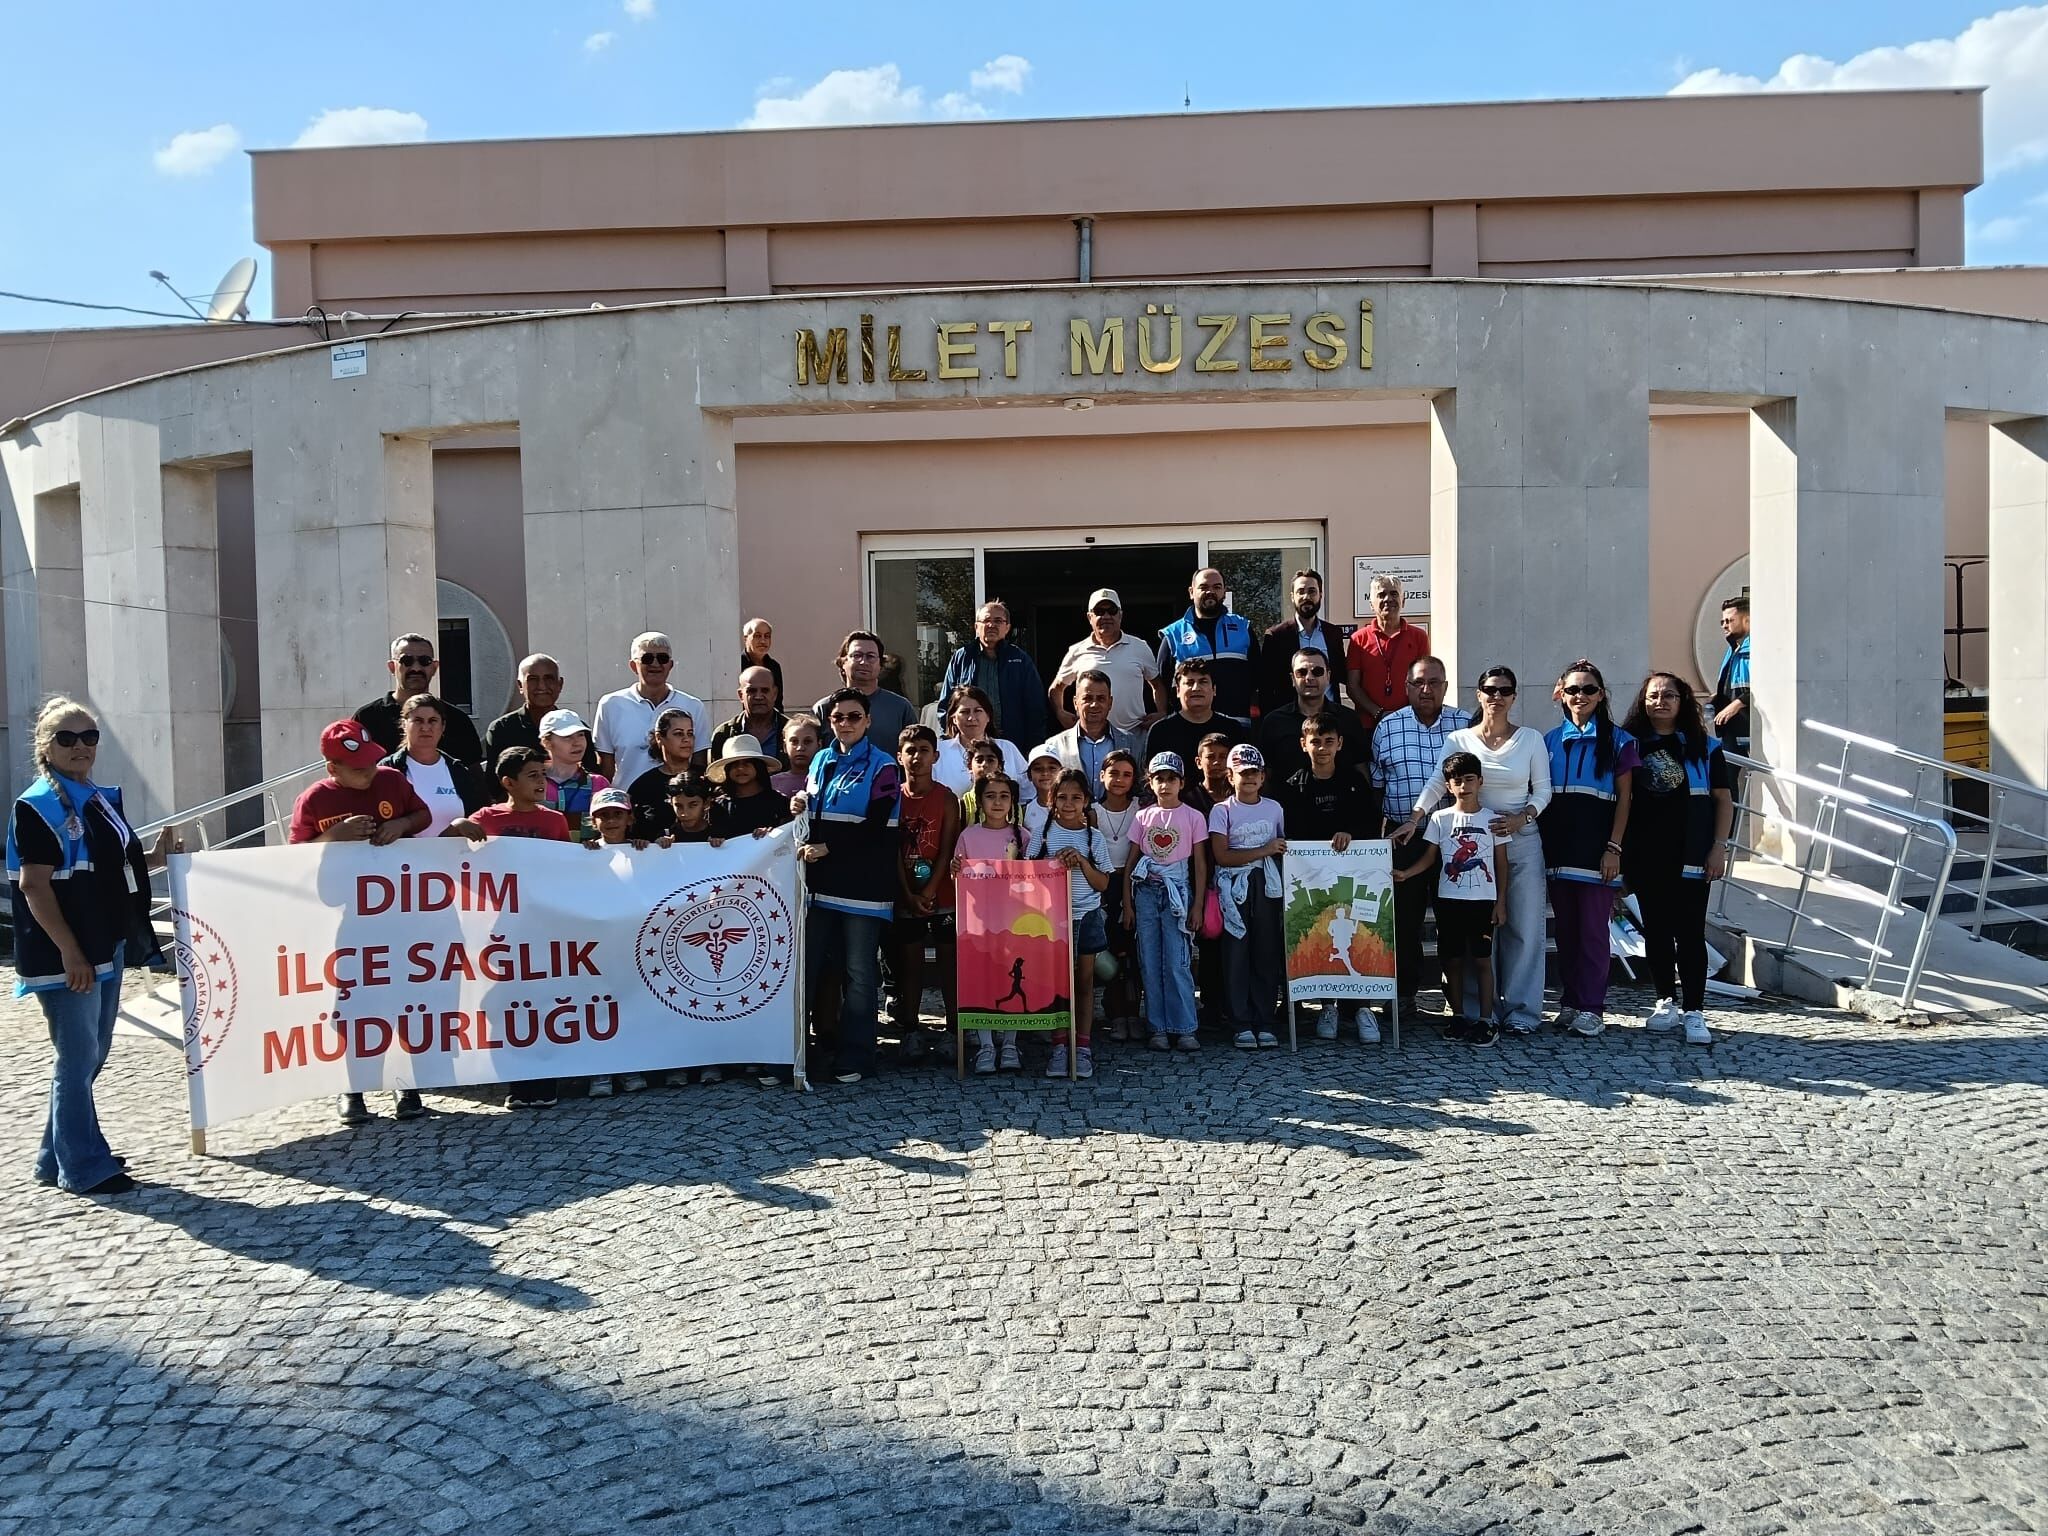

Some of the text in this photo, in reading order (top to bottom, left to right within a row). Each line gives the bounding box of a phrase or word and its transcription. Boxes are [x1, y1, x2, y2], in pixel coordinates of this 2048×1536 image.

[795, 298, 1374, 385] MİLET MÜZESİ
[1403, 590, 1430, 600] ÜZESİ
[356, 861, 519, 916] DİDİM
[276, 933, 602, 1001] İLÇE SAĞLIK
[665, 897, 767, 987] TÜRKİYE CUMHURİYETİ SAĞLIK BAKANLIĞI
[177, 947, 207, 1036] ĞLIK BAKANLIĞ
[263, 994, 619, 1074] MÜDÜRLÜĞÜ
